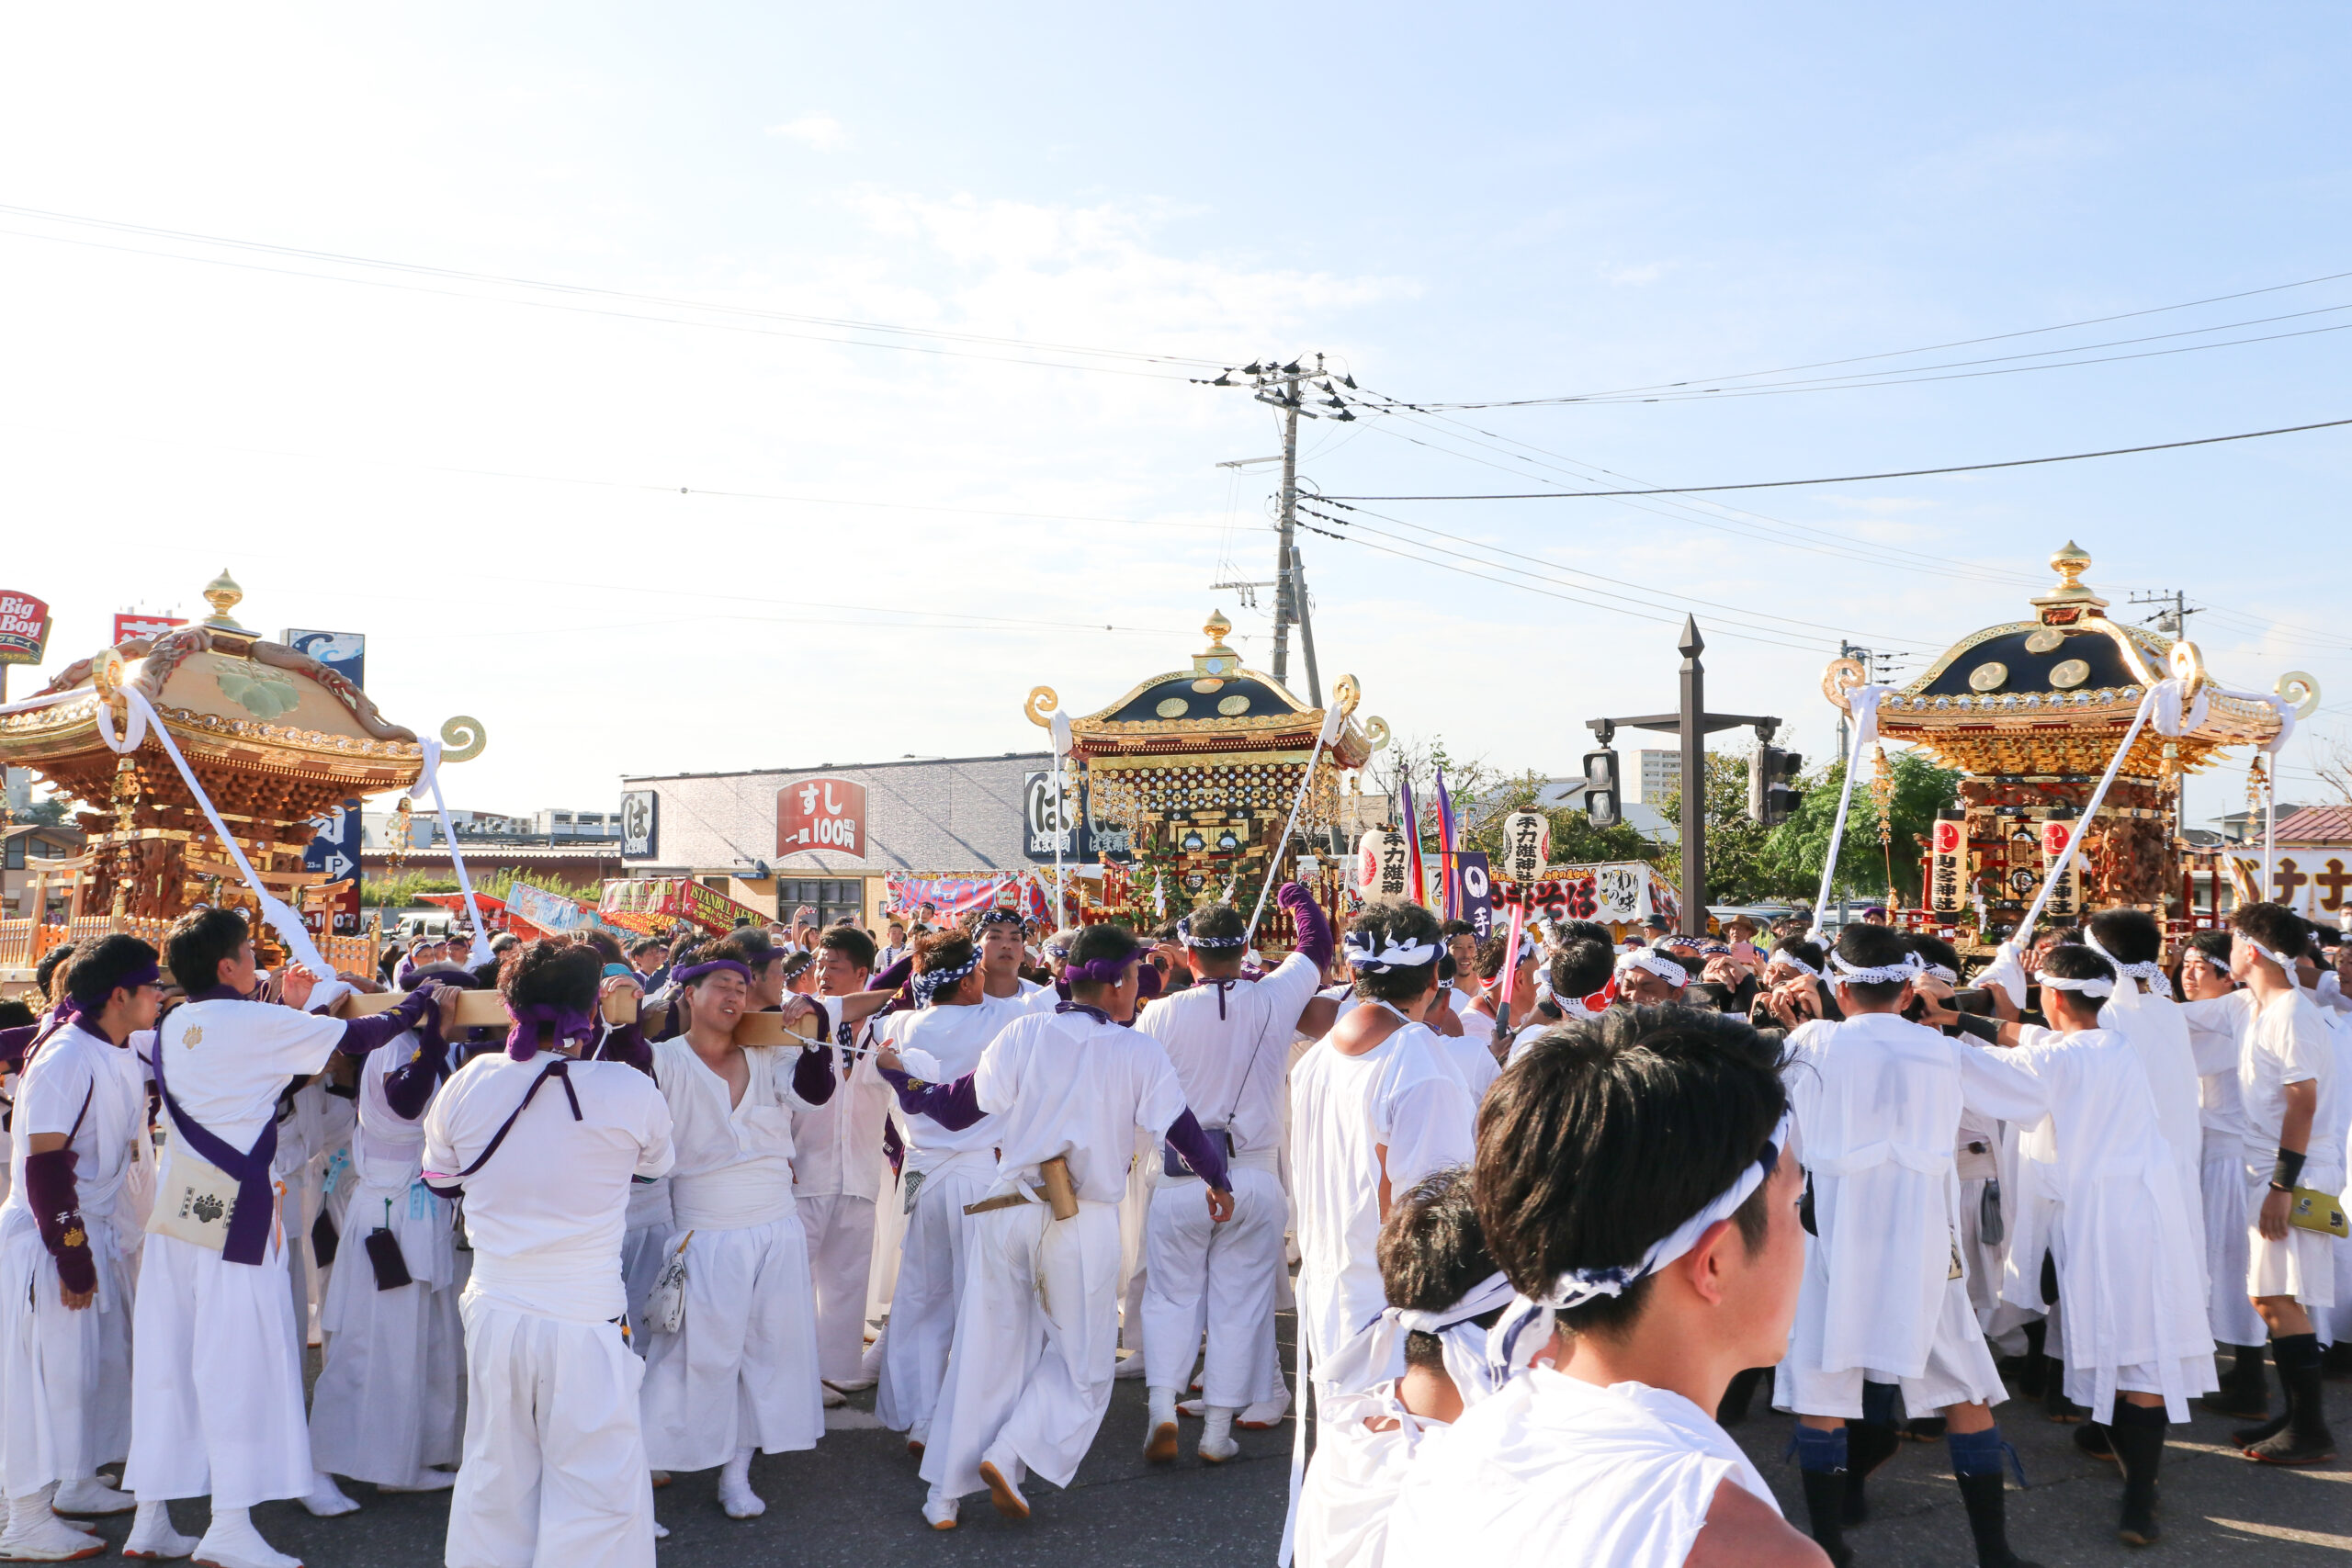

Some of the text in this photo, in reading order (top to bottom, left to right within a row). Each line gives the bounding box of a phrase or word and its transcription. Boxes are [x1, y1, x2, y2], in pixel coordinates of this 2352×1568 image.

[0, 596, 35, 620] Big
[0, 615, 42, 638] Boy
[799, 783, 842, 816] すし
[1382, 833, 1406, 895] 手力雄神
[1516, 816, 1538, 881] 手力雄神社
[690, 885, 732, 915] ISTANBUL
